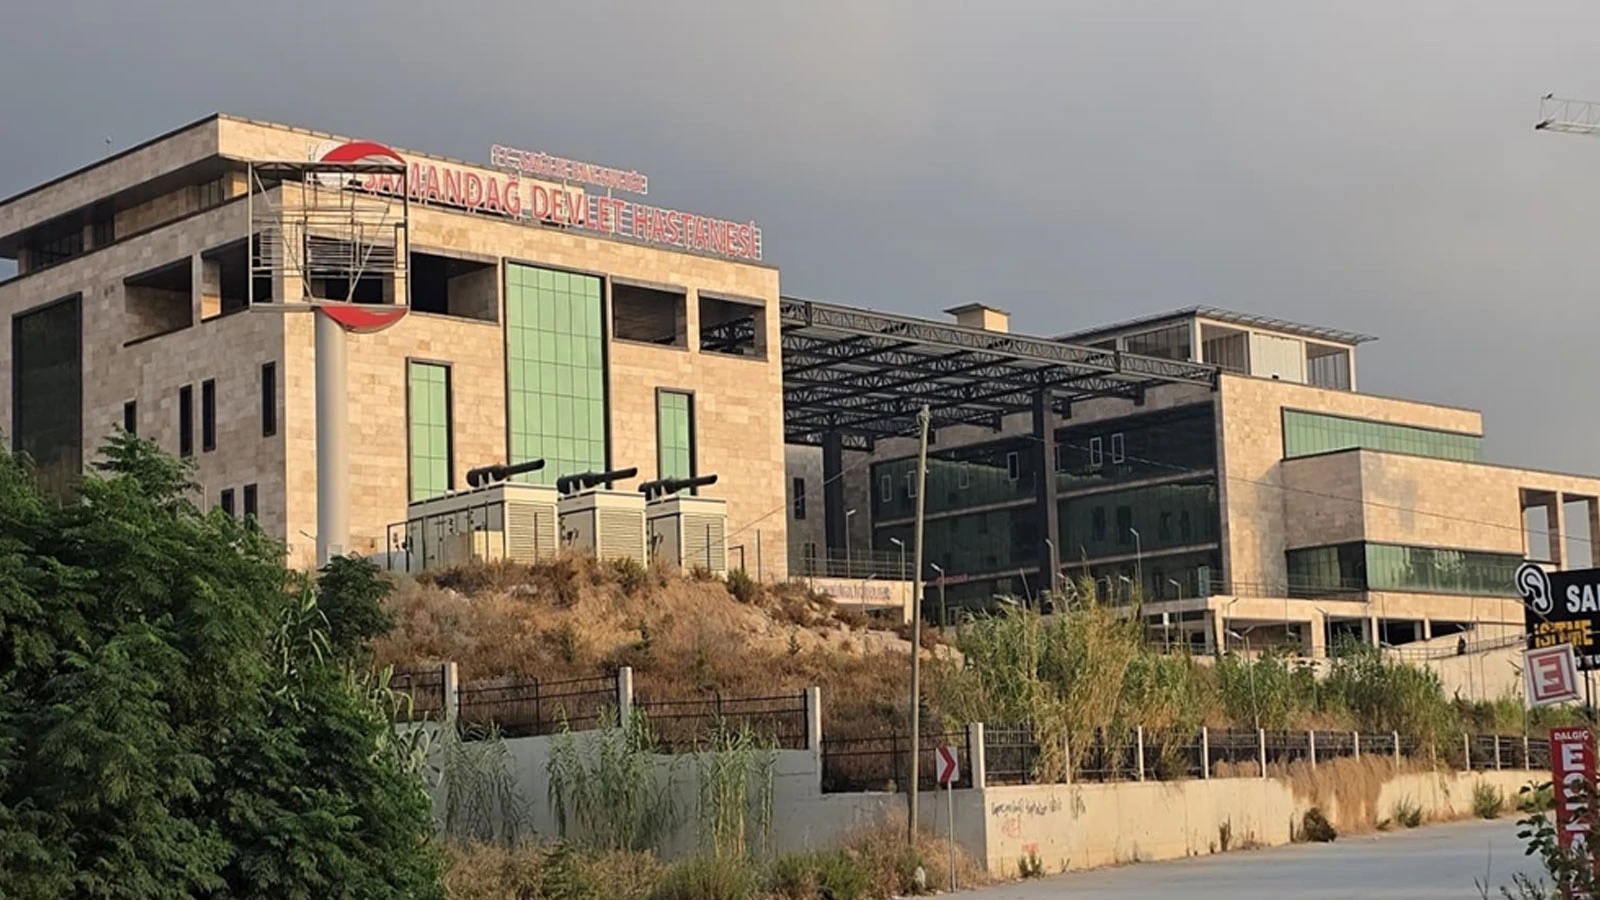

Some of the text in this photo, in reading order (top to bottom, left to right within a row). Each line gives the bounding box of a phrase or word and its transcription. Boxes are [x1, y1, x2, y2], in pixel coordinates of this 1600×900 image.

[531, 184, 626, 234] DEVLET
[632, 202, 757, 258] HASTANESİ
[1566, 583, 1600, 613] SA
